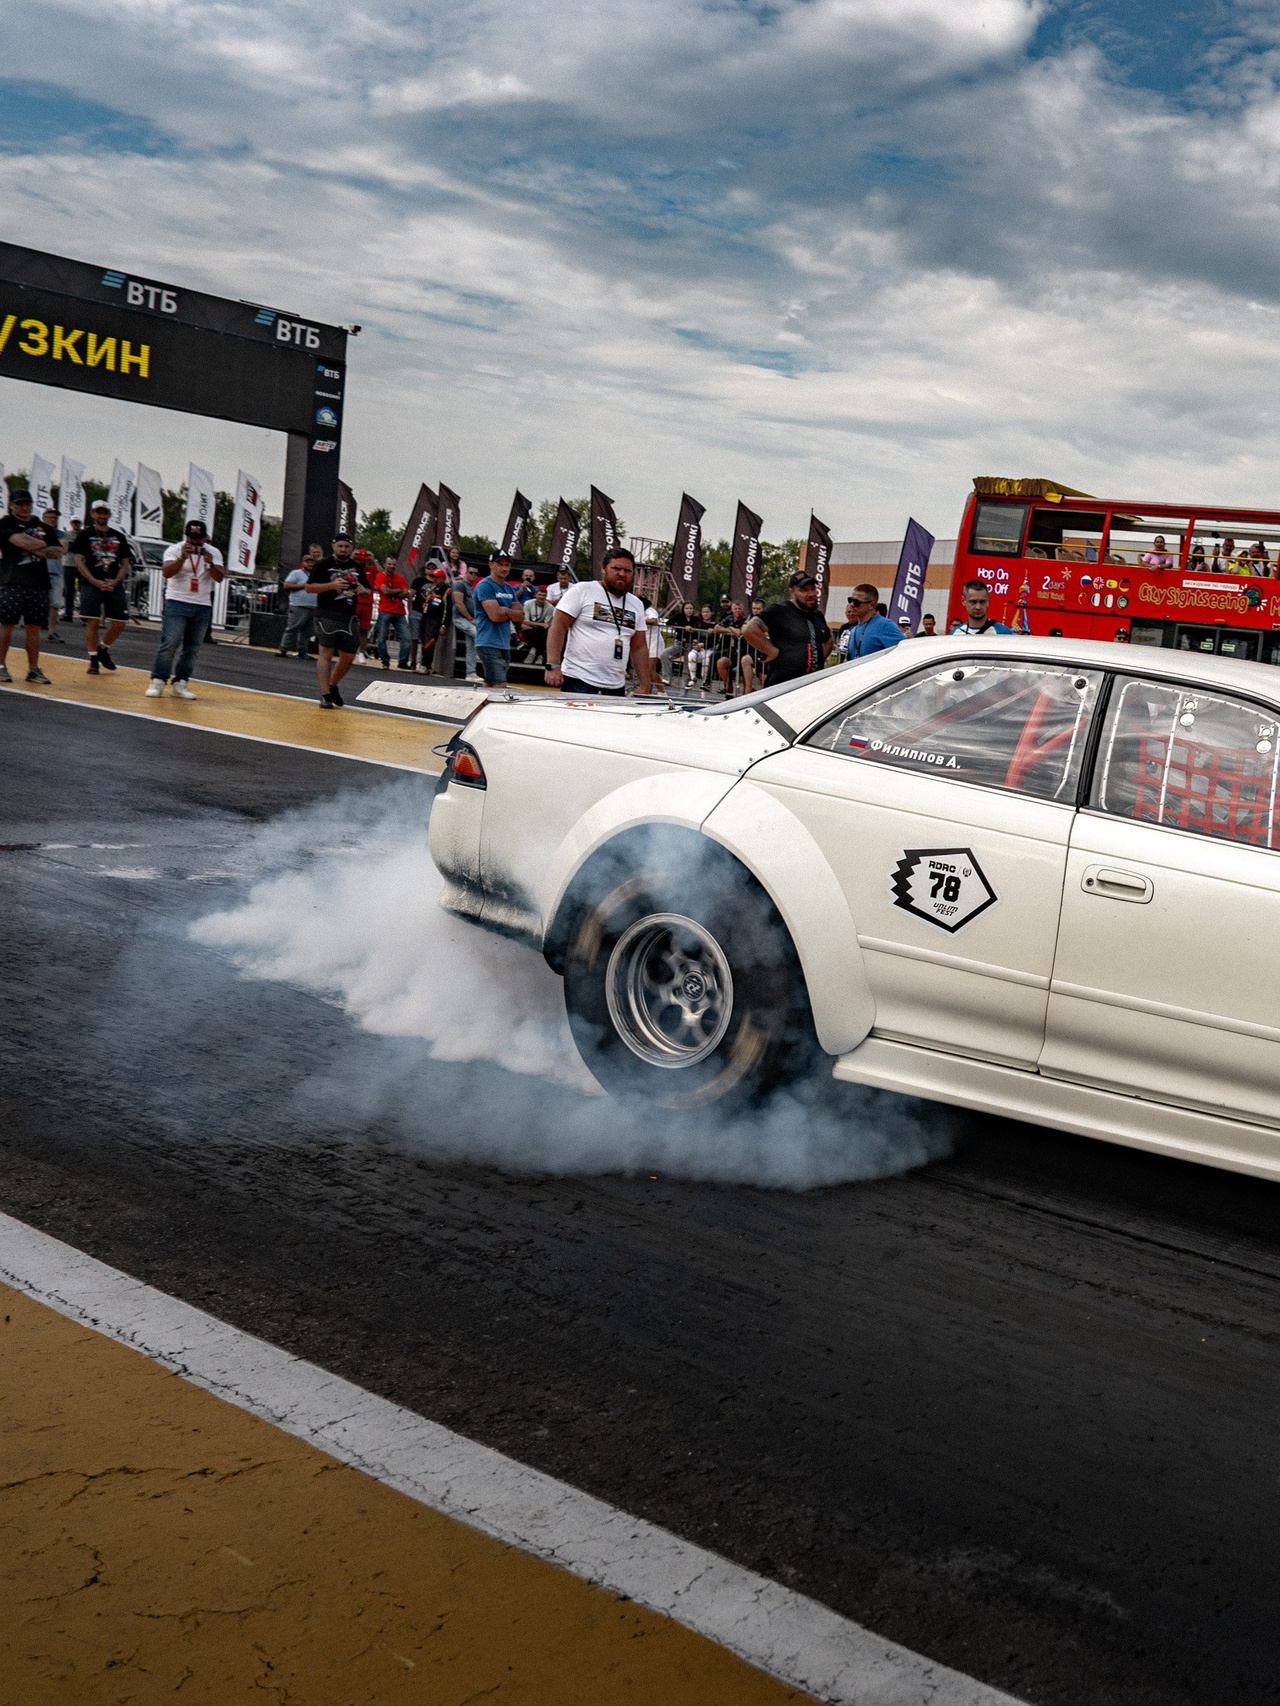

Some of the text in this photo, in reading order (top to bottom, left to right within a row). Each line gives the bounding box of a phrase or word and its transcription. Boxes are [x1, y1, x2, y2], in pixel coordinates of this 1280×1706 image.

[126, 280, 178, 314] ВТБ
[275, 318, 321, 349] ВТБ
[323, 368, 340, 379] ВТБ
[197, 493, 208, 521] НОЛИТ
[562, 530, 576, 565] GONKI
[683, 524, 699, 581] ROSGONKI
[745, 537, 758, 596] ROSGONKI
[815, 545, 827, 603] OSGONKI
[903, 562, 922, 600] ВТБ
[977, 567, 1009, 580] Hop On
[994, 582, 1009, 595] Off
[1138, 583, 1250, 613] City Sightseeing
[870, 740, 962, 769] Филиппов А.
[929, 860, 956, 873] RDRC
[929, 871, 962, 903] 78
